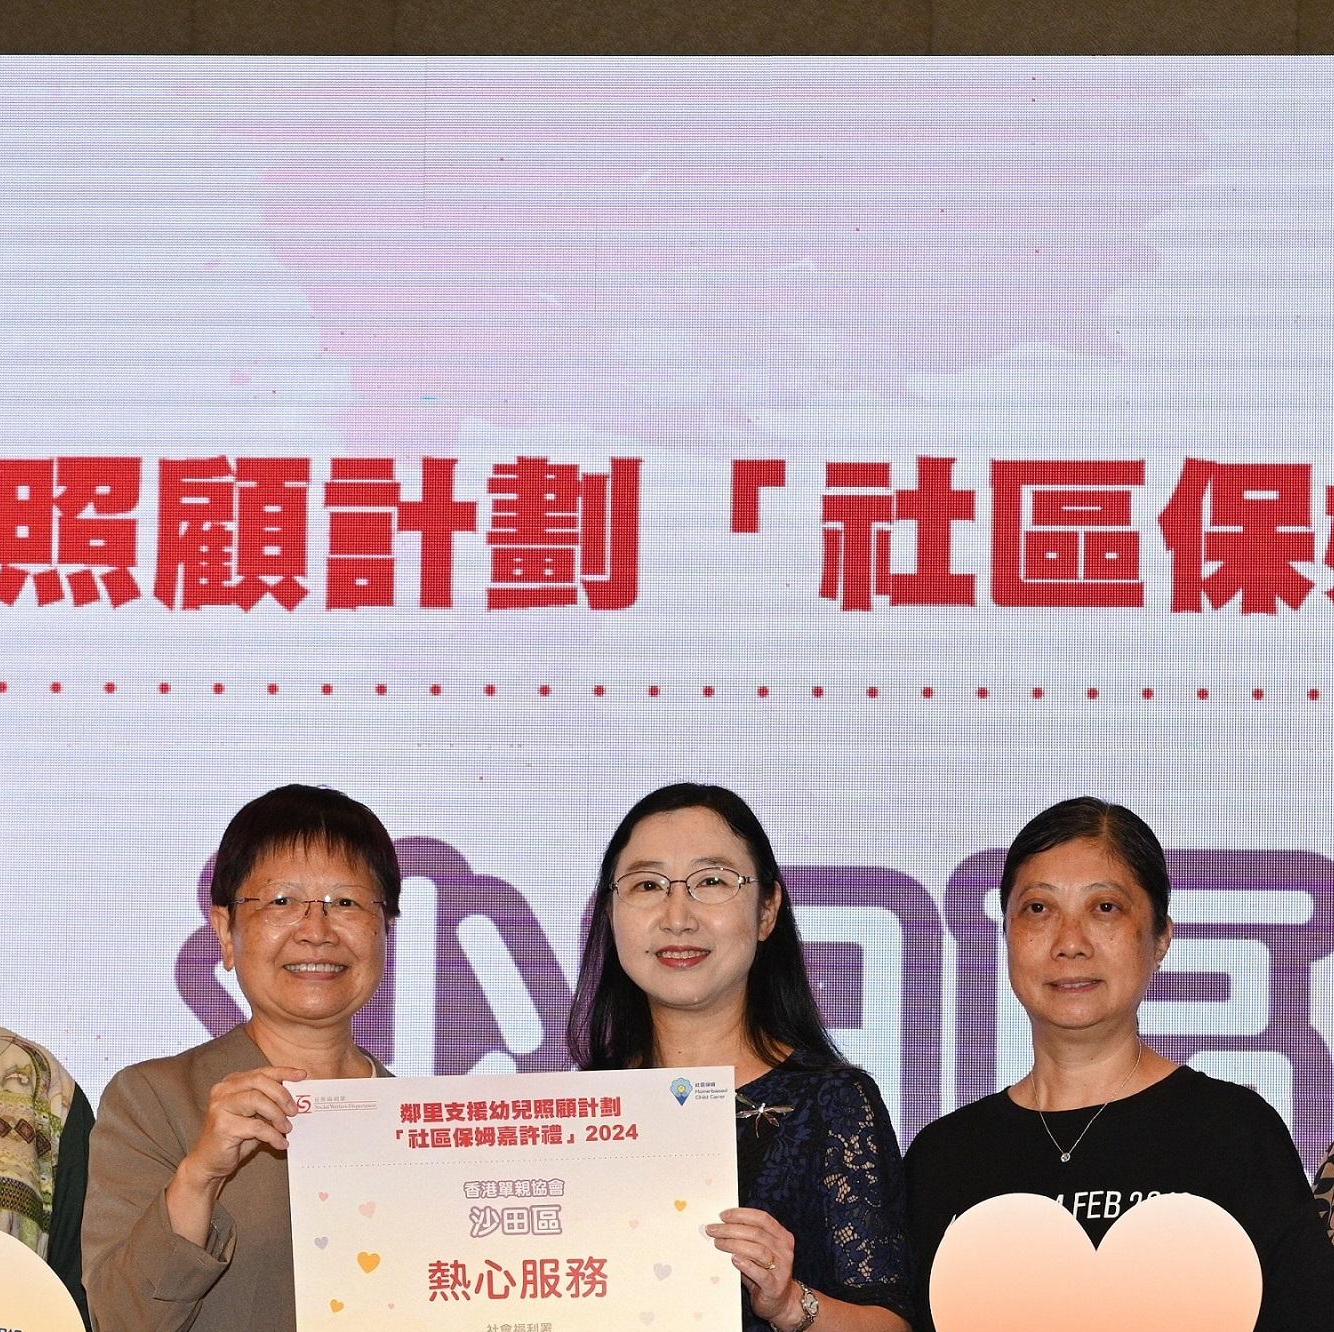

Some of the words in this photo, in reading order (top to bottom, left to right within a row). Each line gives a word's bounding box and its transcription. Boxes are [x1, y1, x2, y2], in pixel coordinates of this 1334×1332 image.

[399, 1096, 621, 1123] 鄰里支援幼兒照顧計劃
[585, 1123, 639, 1142] 2024
[463, 1177, 565, 1199] 香港單親協會
[1073, 1190, 1123, 1220] FEB
[469, 1204, 563, 1238] 沙田區
[428, 1256, 608, 1302] 熱心服務
